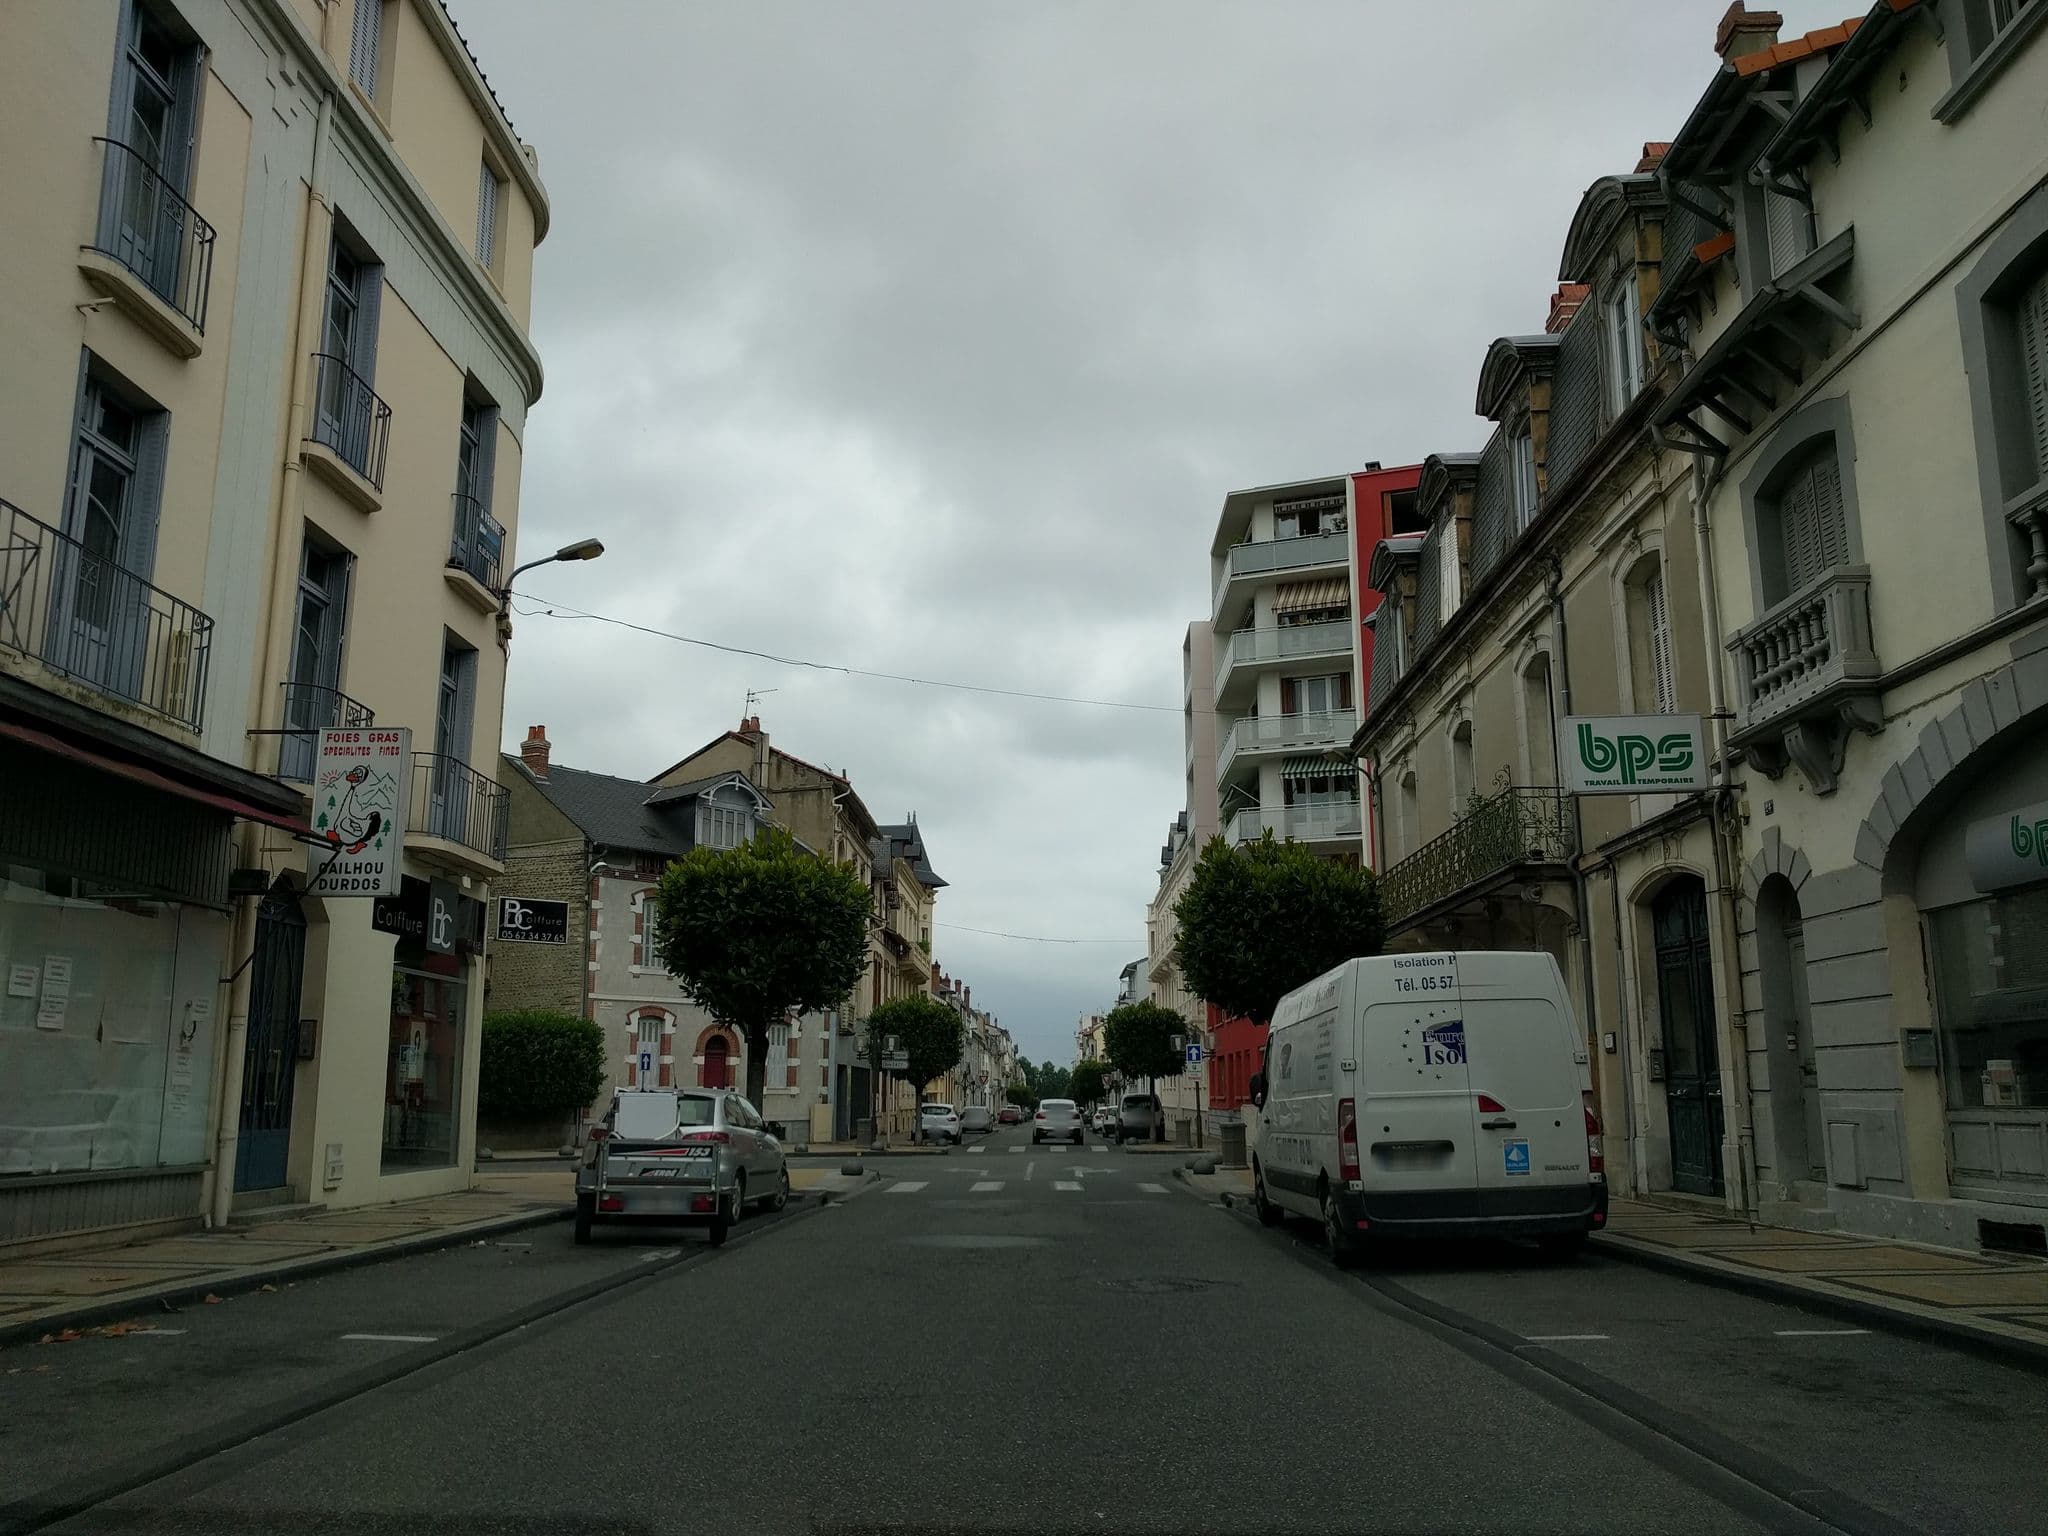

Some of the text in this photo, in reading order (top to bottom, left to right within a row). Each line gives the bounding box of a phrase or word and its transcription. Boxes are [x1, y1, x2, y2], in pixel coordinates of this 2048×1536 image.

[326, 732, 399, 743] FOIES GRAS
[323, 746, 400, 756] SPECIALITES FINES
[1577, 723, 1693, 785] bps
[1584, 777, 1694, 786] TRAVAIL TEMPORAIRE
[318, 878, 380, 890] DURDOS
[376, 904, 424, 934] Coiffure
[432, 897, 453, 949] BC
[1393, 957, 1445, 969] Isolation
[1395, 975, 1453, 991] Tél. 05 57
[689, 1147, 711, 1156] 153
